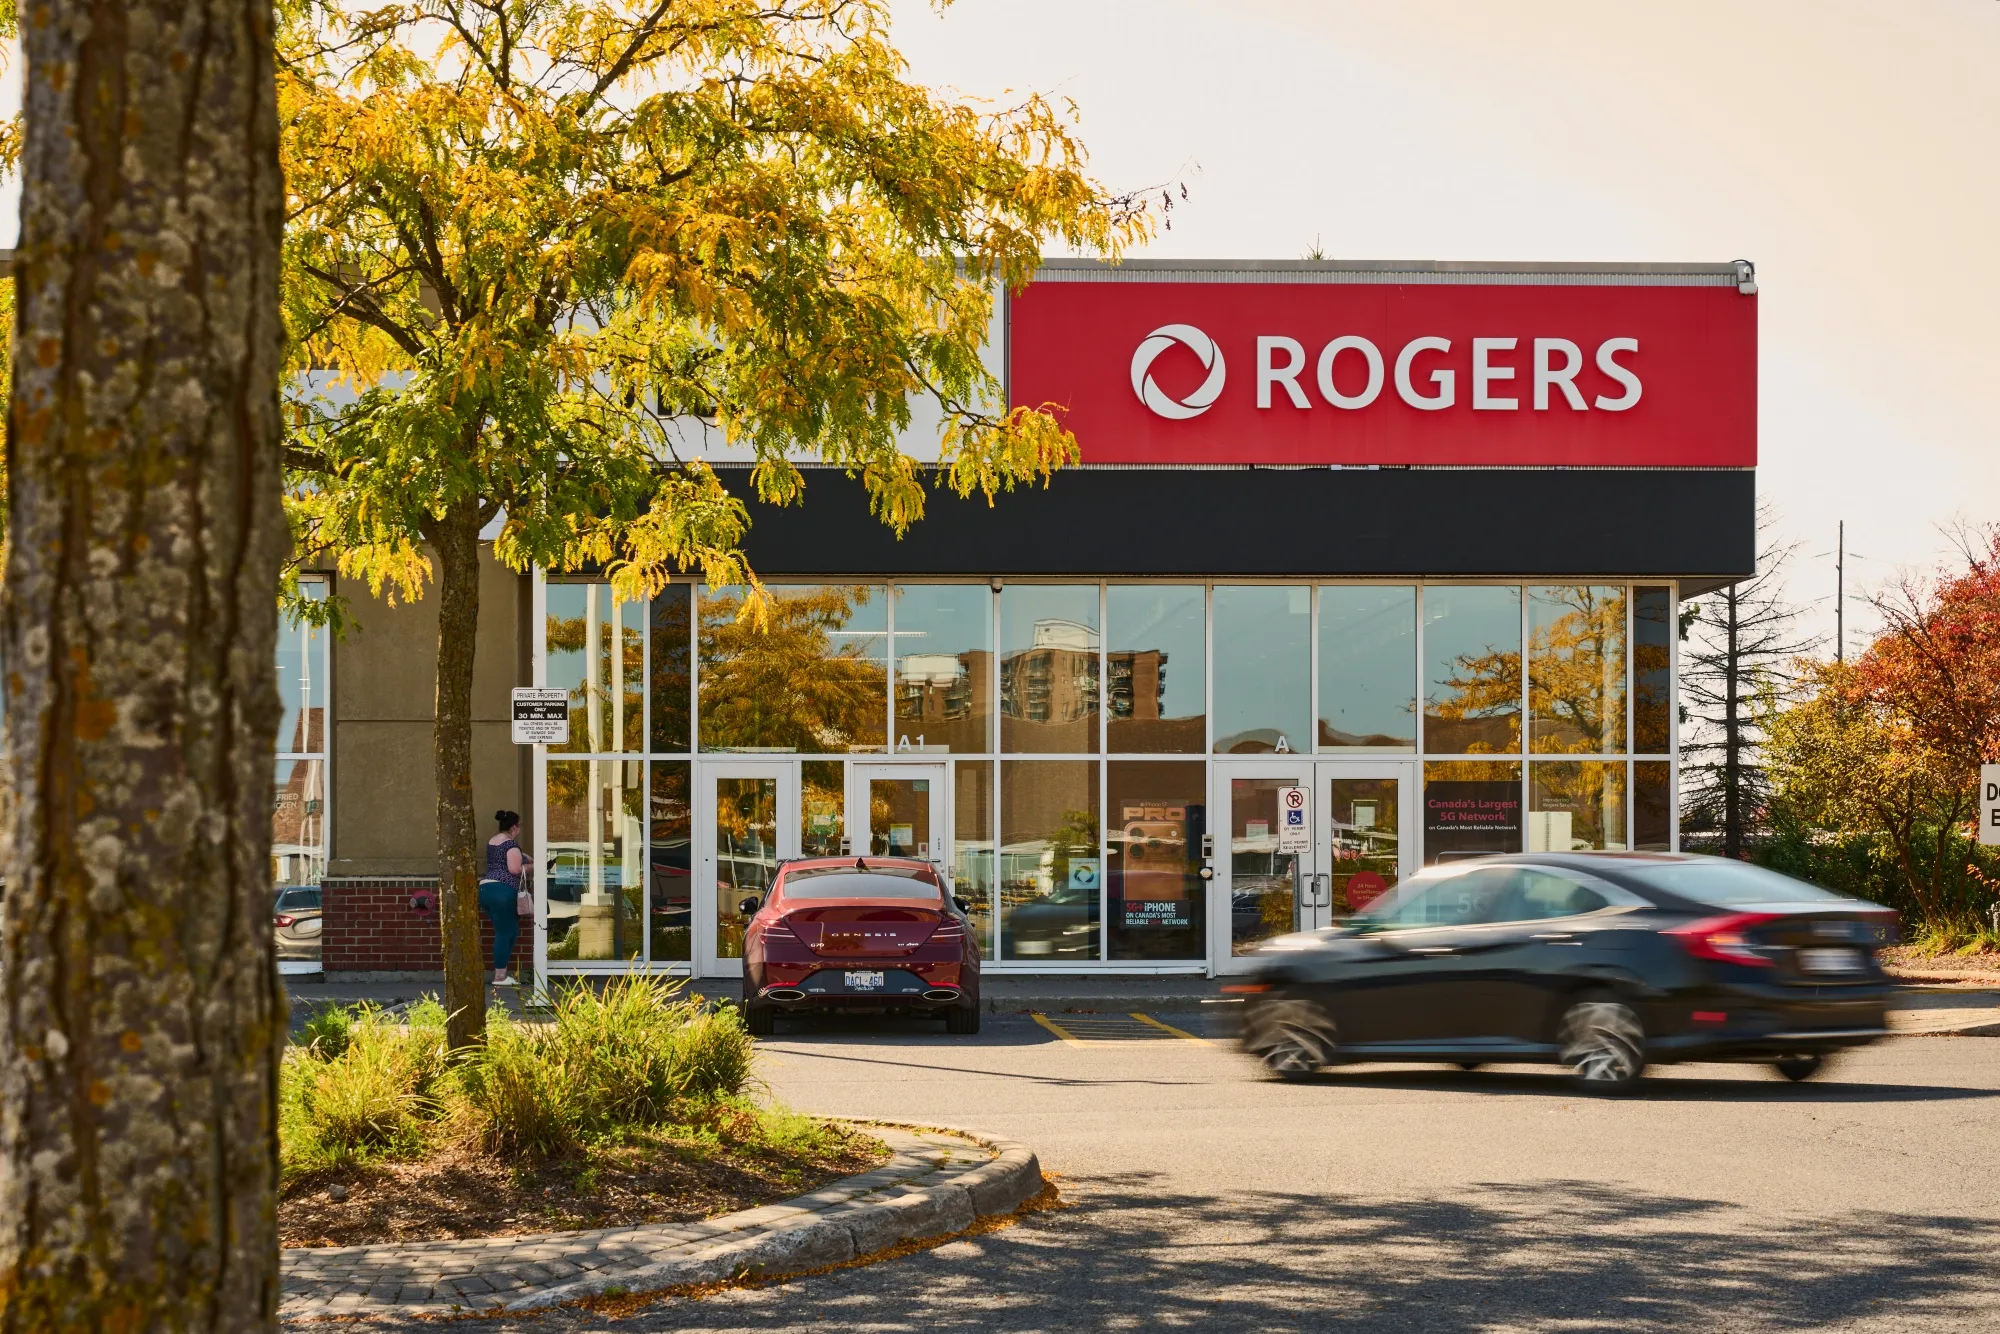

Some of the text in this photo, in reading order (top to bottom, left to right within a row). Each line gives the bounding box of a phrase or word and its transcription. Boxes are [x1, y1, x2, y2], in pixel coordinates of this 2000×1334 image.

[1256, 335, 1643, 412] ROGERS
[1274, 735, 1290, 752] A
[276, 793, 299, 801] FRIED
[1986, 782, 2000, 801] D
[273, 801, 297, 809] ICKEN
[1428, 799, 1518, 811] Canada's Largest
[1123, 807, 1186, 821] PRO
[1440, 811, 1506, 821] 5G Network
[1144, 902, 1176, 911] iPHONE
